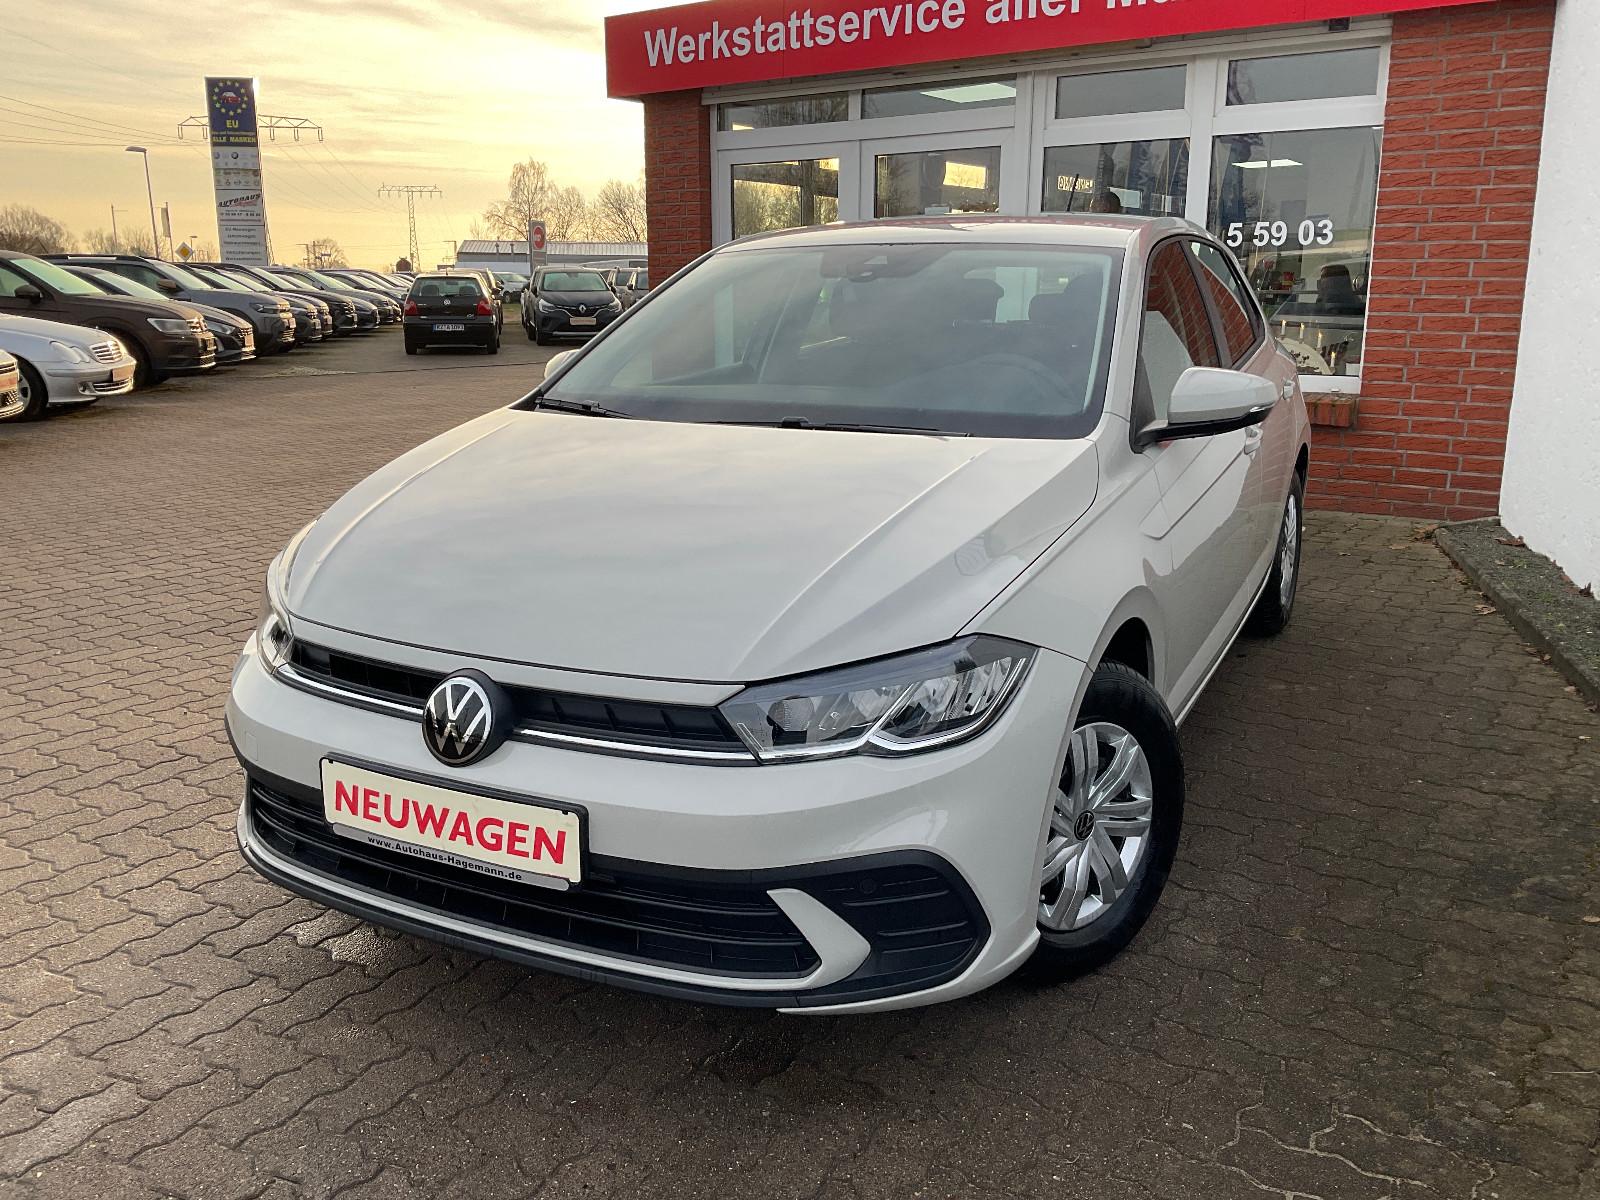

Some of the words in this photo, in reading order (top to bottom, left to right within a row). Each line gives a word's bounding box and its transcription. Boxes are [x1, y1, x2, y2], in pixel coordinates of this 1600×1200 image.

[644, 0, 965, 67] Werkstattservice
[226, 119, 239, 128] EU
[1226, 222, 1243, 248] 5
[1252, 220, 1288, 247] 59
[1297, 219, 1334, 246] 03
[335, 779, 567, 865] NEUWAGEN
[367, 834, 523, 882] www.Autohaus-Hagemann.de
